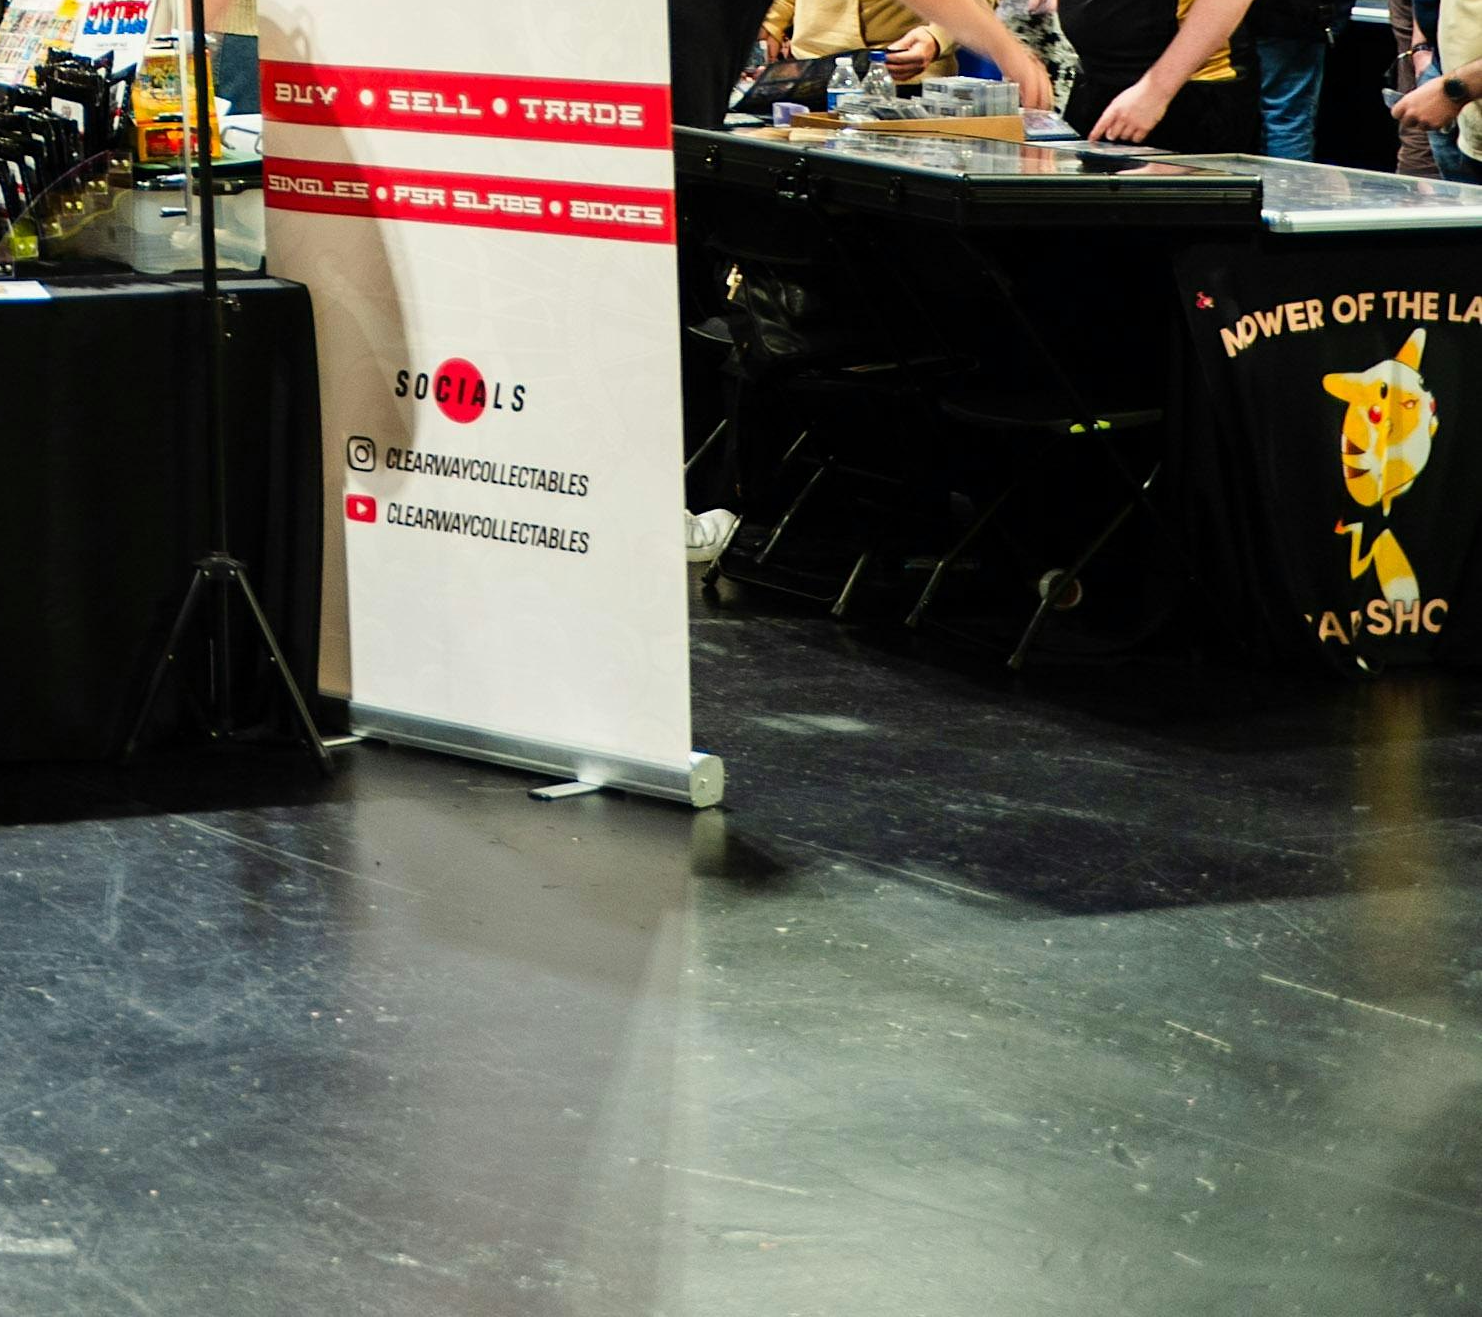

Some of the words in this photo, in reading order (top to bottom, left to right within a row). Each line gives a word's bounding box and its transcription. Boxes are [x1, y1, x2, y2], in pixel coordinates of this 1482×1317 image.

[274, 82, 337, 105] BUY
[388, 89, 483, 117] SELL
[519, 97, 644, 128] TRADE
[267, 174, 370, 200] SINGLES
[393, 184, 446, 208] PSA
[452, 189, 543, 216] SLABS
[569, 199, 664, 226] BOXES
[1331, 291, 1376, 325] OF
[1383, 290, 1439, 322] THE
[395, 369, 526, 413] SOCIALS
[385, 446, 590, 498] CLEARWAYCOLLECTABLES
[386, 502, 591, 555] CLEARWAYCOLLECTABLES
